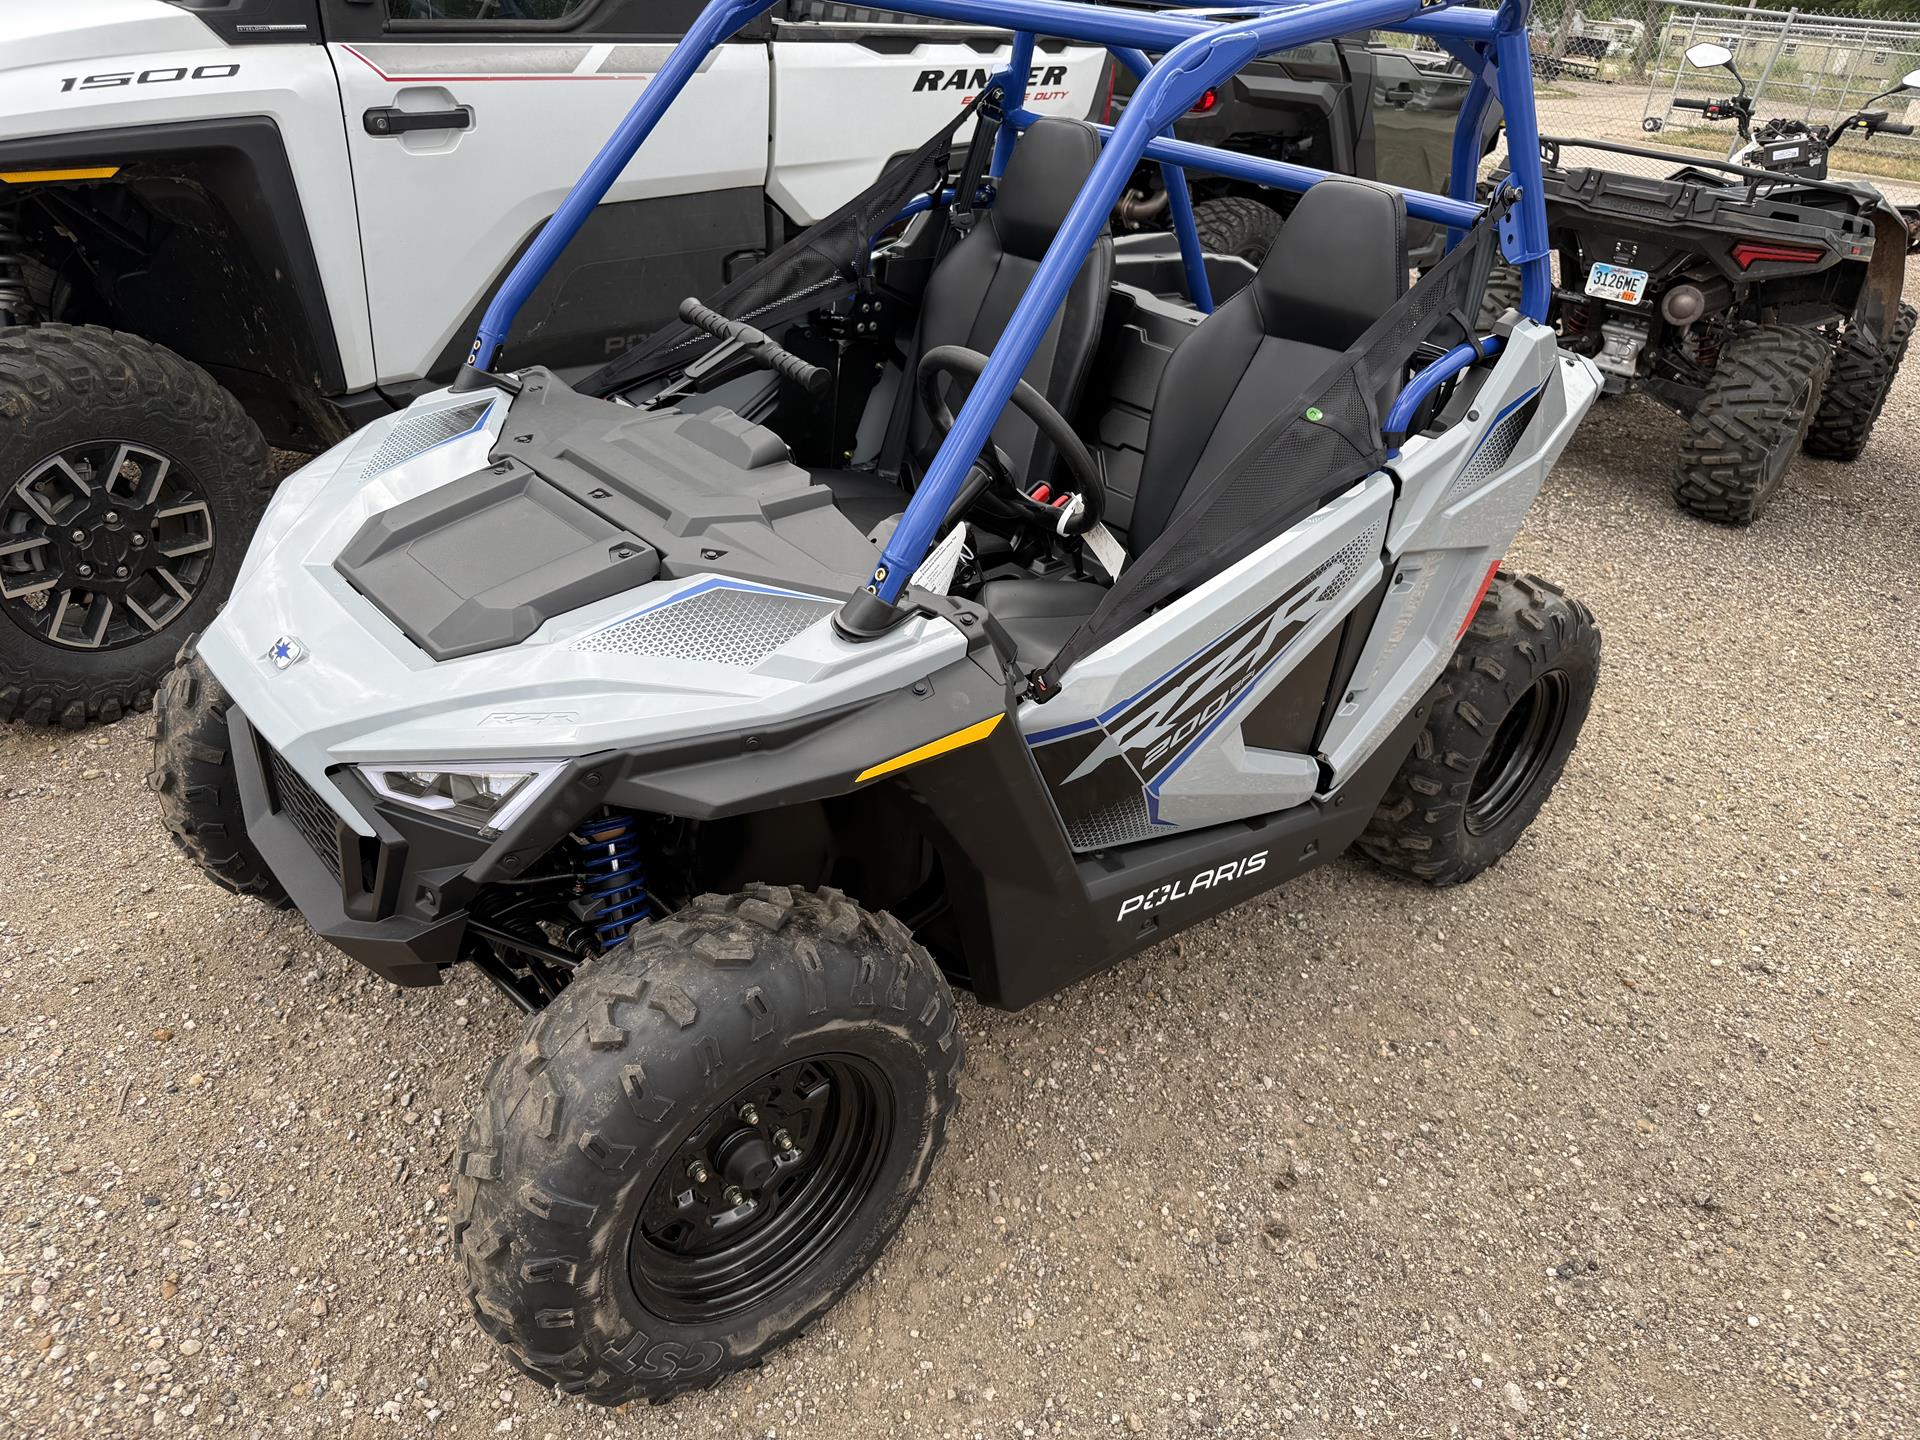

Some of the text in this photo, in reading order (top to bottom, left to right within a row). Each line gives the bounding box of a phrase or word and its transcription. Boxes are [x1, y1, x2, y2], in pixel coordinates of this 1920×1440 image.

[60, 63, 241, 93] 1500
[912, 65, 1068, 92] RANER
[1033, 91, 1070, 101] DUTY
[1593, 270, 1641, 293] 3126ME
[1059, 560, 1346, 786] RZR
[1141, 690, 1230, 770] 200
[1116, 849, 1270, 923] POLARIS
[600, 1330, 725, 1381] CST
